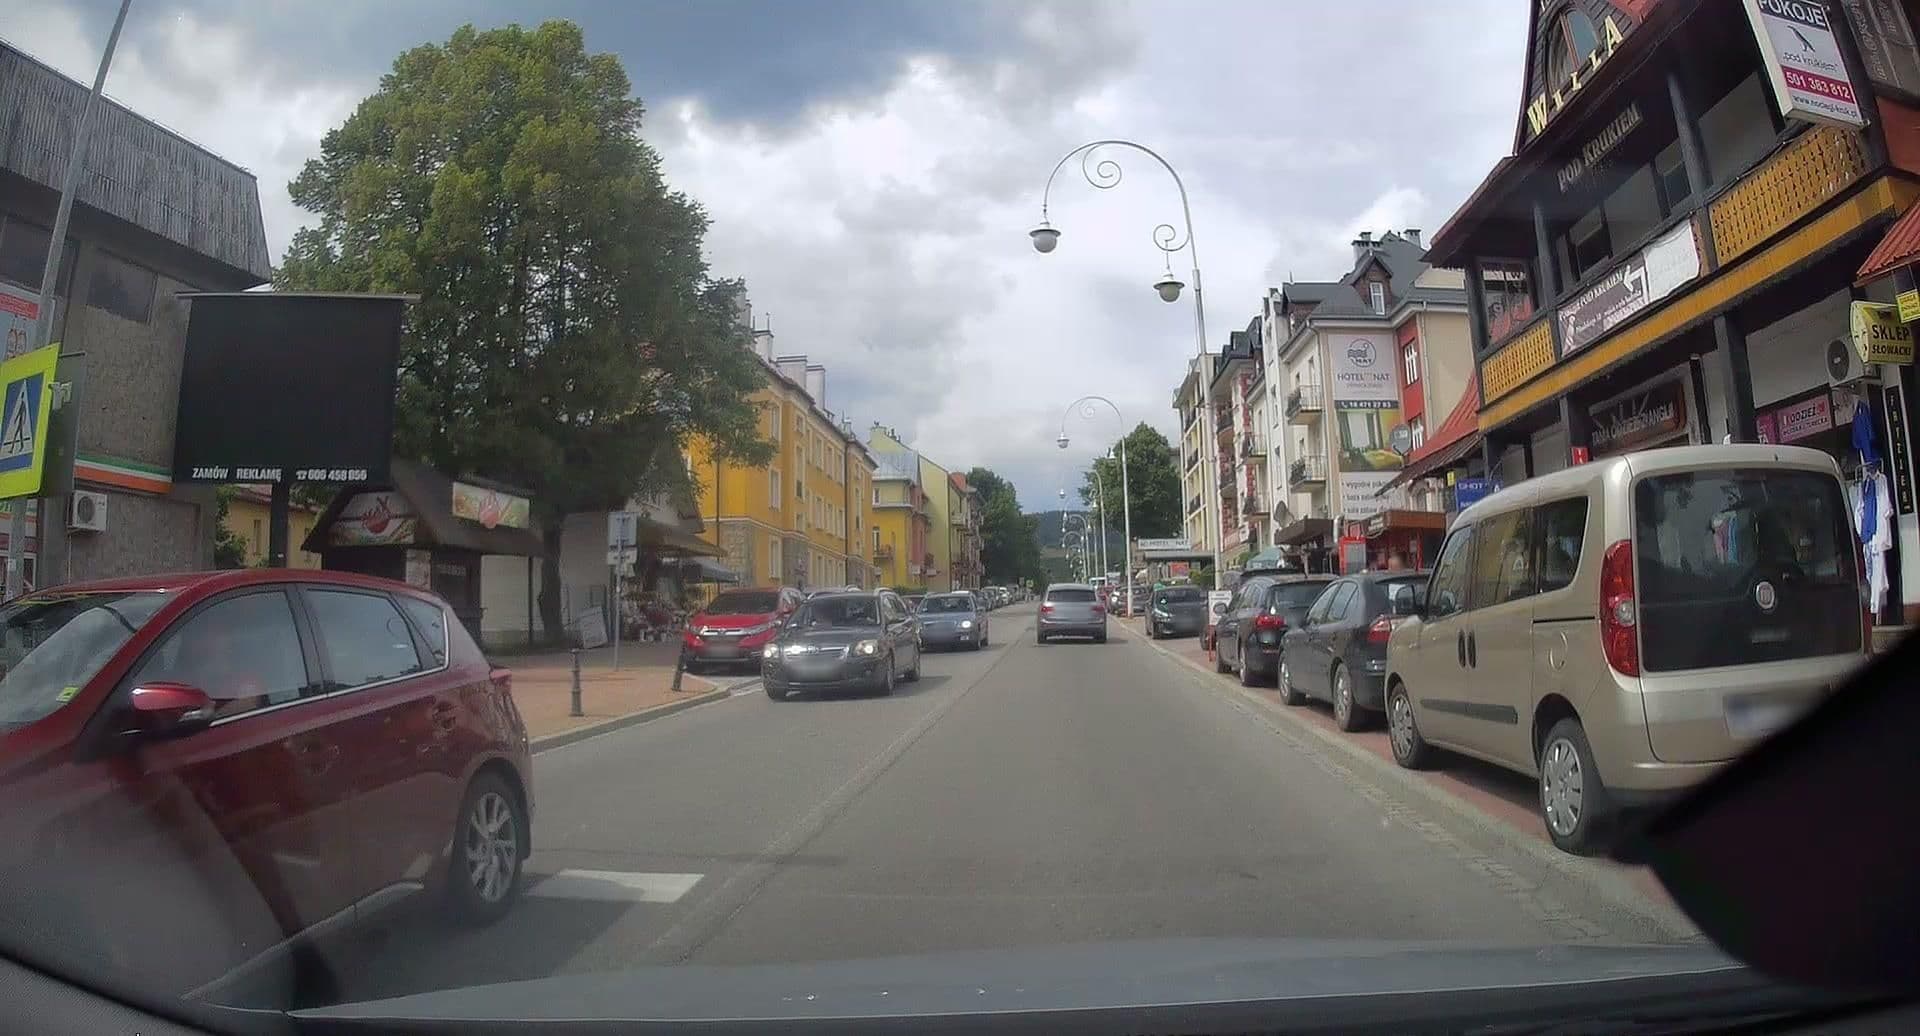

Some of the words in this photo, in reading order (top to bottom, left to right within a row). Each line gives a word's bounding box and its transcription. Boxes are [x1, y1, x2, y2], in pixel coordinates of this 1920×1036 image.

[1527, 15, 1624, 136] WILLA
[1786, 71, 1807, 88] 501
[1809, 78, 1829, 94] 383
[1830, 83, 1851, 99] 812
[1557, 157, 1584, 193] POD
[1582, 102, 1644, 167] KRUKIEM
[1871, 324, 1910, 341] SKLEP
[1871, 344, 1912, 356] SŁOWACKI
[1337, 373, 1363, 381] HOTEL
[1374, 373, 1390, 381] NAT
[192, 465, 229, 479] ZAMÓW
[236, 468, 282, 482] REKLAMĘ
